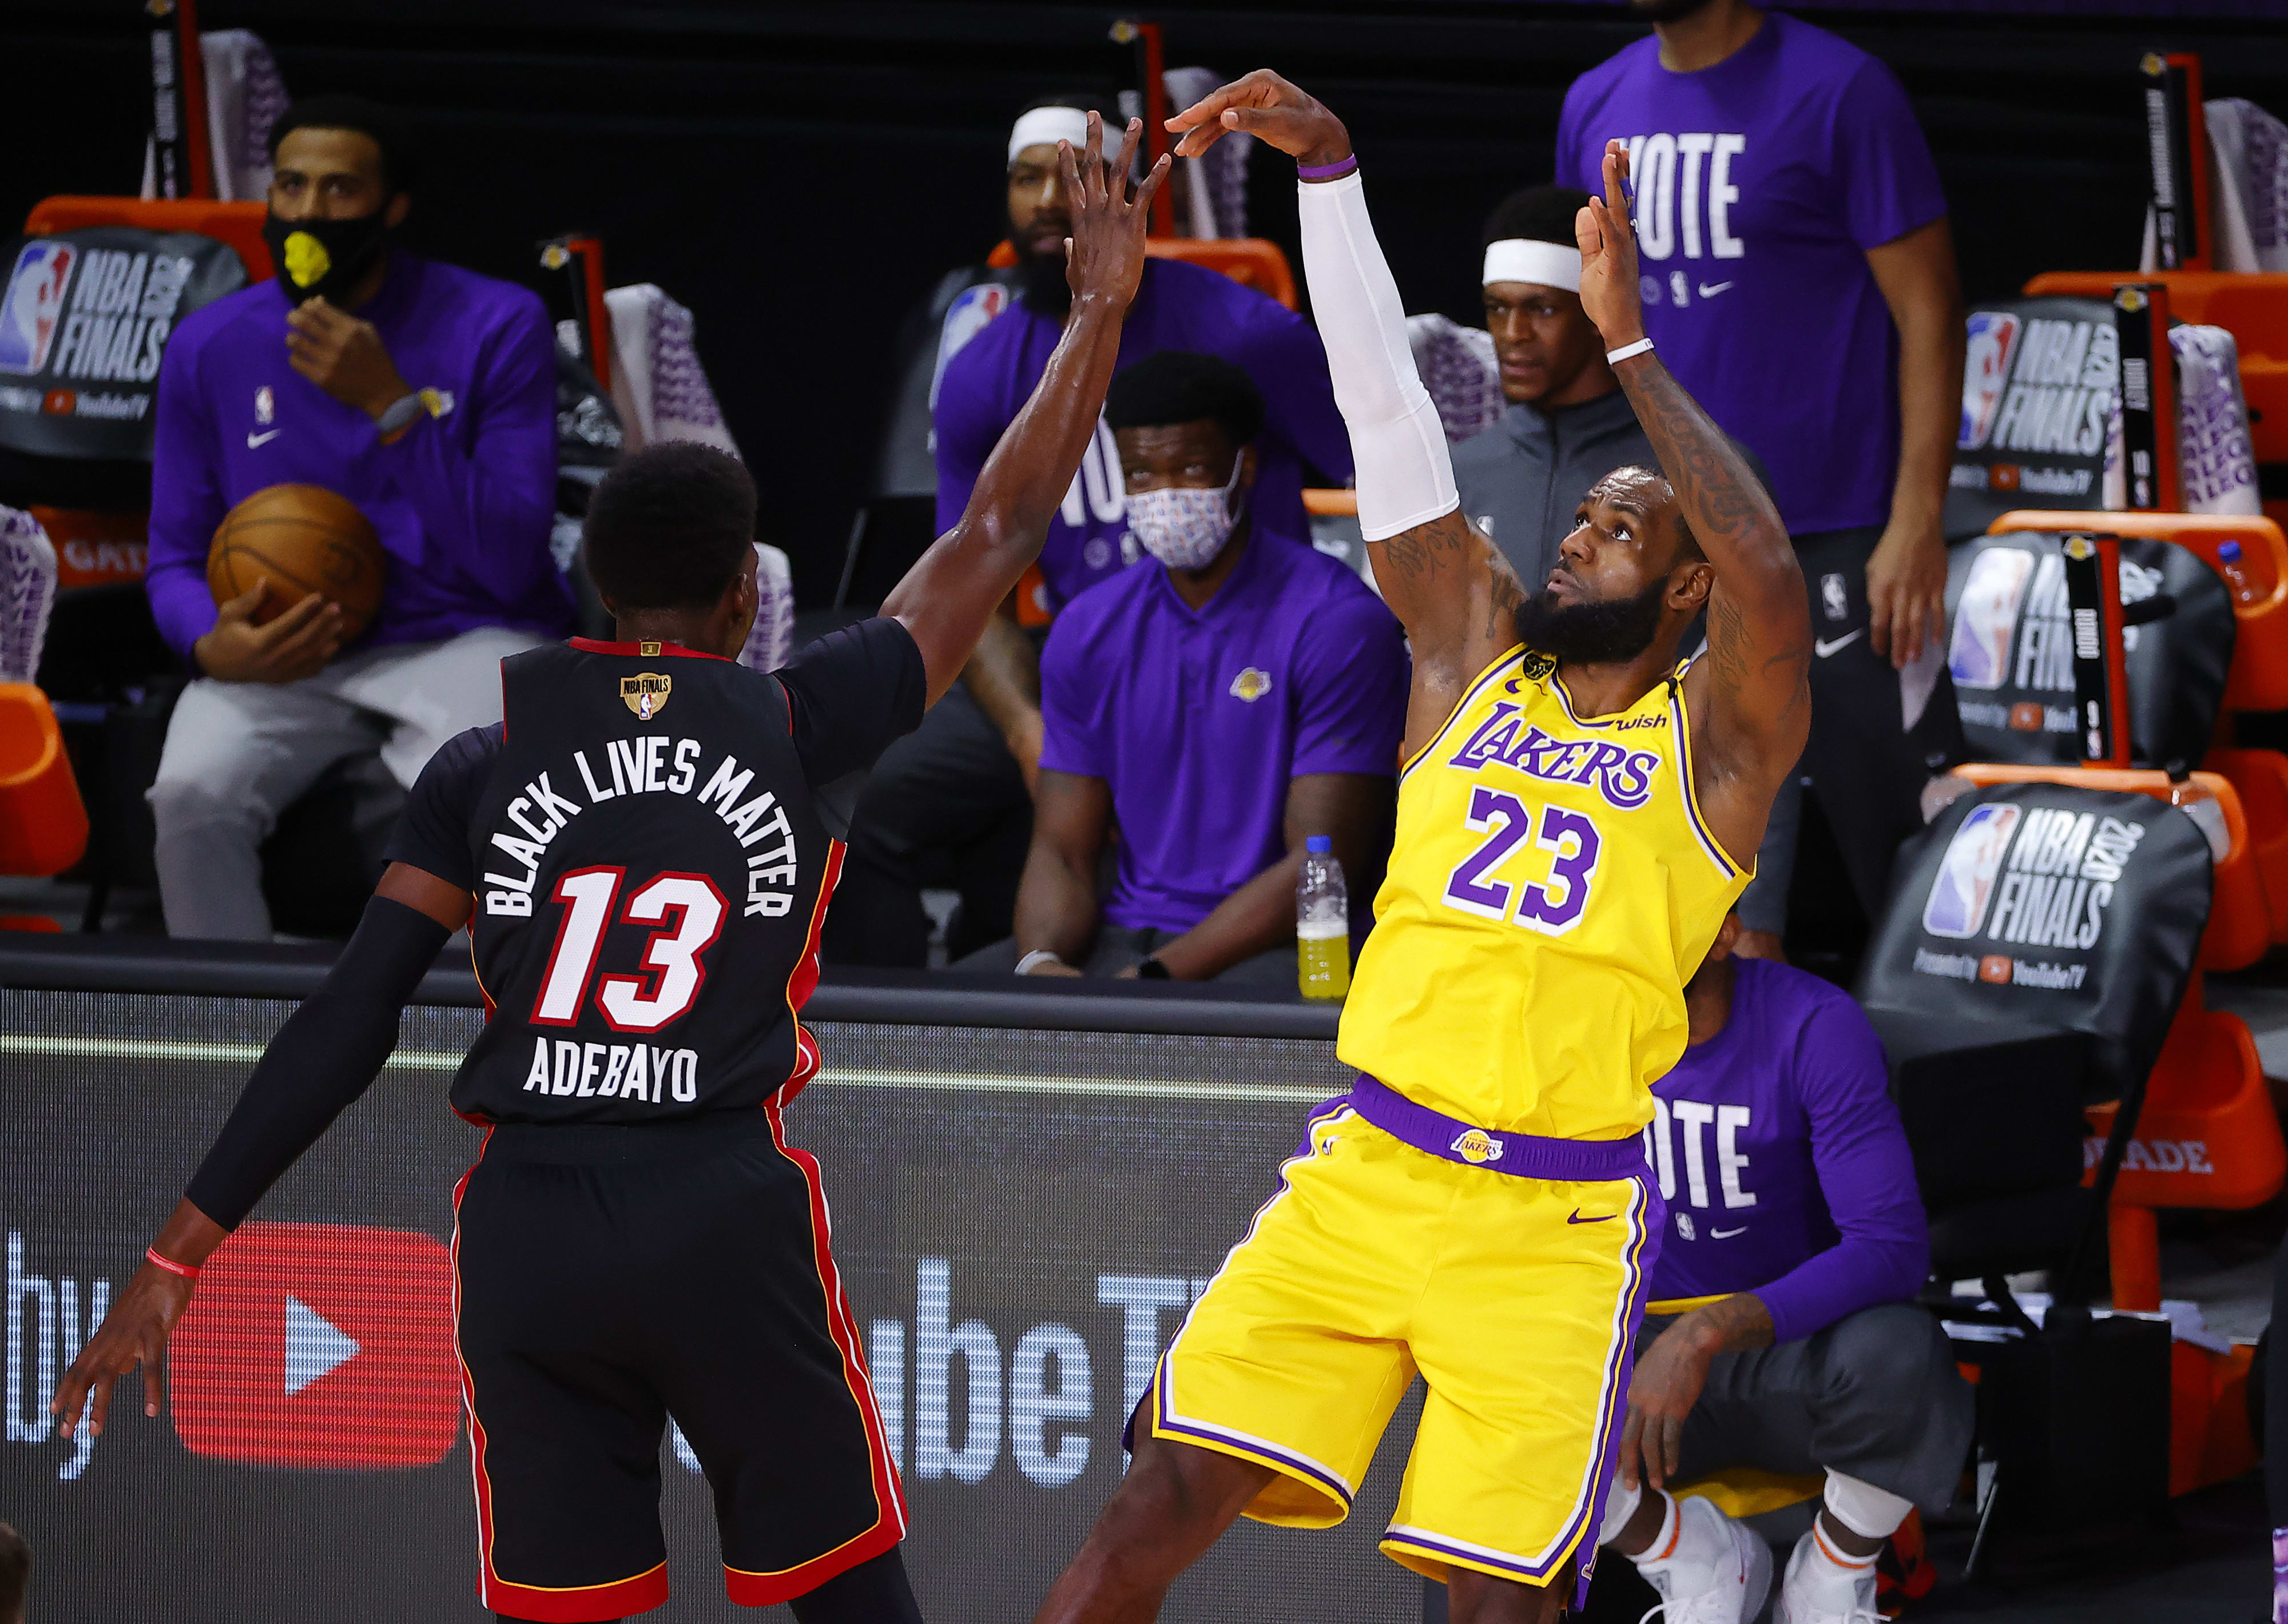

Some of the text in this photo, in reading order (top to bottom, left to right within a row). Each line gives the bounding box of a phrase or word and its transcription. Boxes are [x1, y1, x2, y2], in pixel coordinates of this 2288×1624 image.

[71, 248, 148, 313] NBA
[53, 313, 171, 383] FINALS
[624, 678, 669, 694] NBA FINALS
[1615, 714, 1667, 731] wish
[1447, 699, 1662, 811] LAKERS
[486, 736, 797, 918] BLACK LIVES MATTER
[1441, 783, 1603, 938] 23
[2007, 807, 2096, 878] NBA
[529, 865, 730, 1033] 13
[1987, 871, 2114, 950] FINALS
[523, 1036, 698, 1104] ADEBAYO
[1643, 1095, 1758, 1209] OTE
[6, 1231, 110, 1480] by
